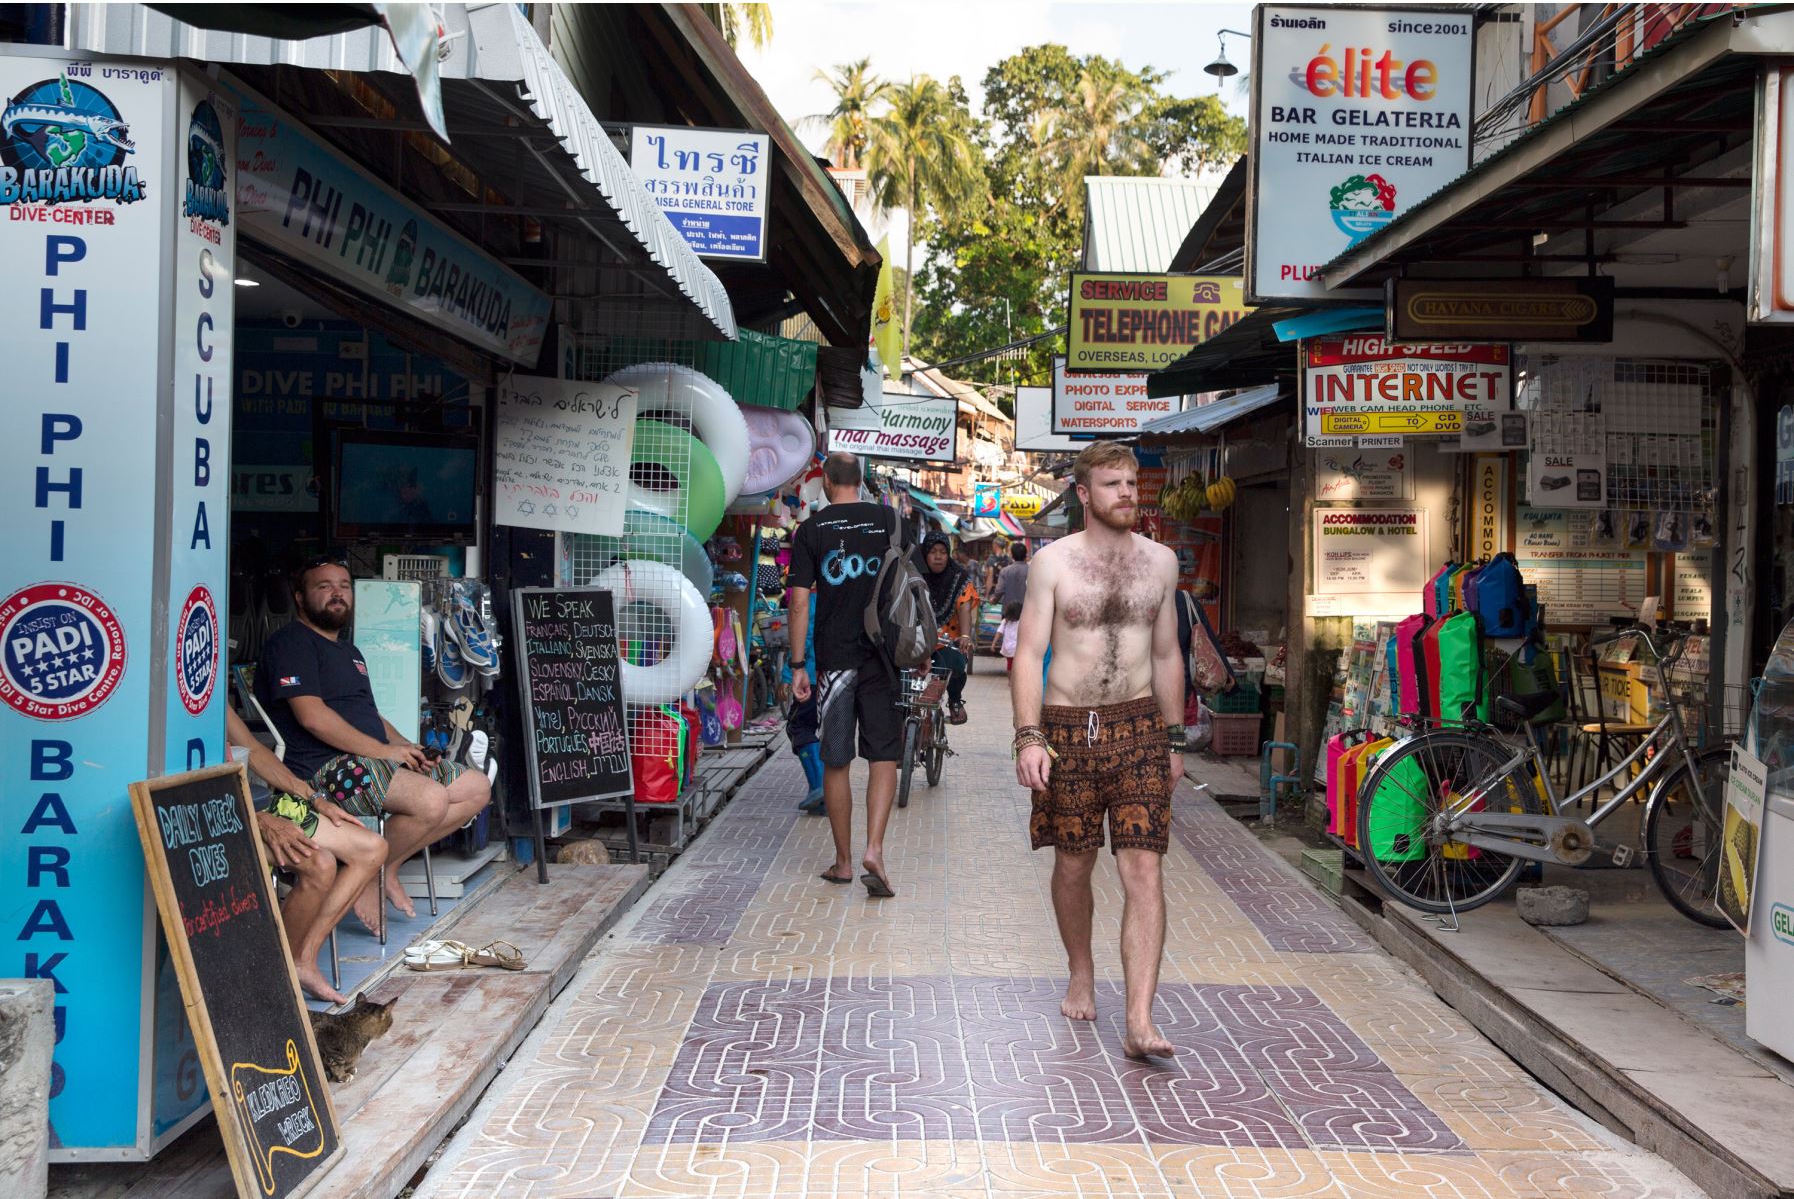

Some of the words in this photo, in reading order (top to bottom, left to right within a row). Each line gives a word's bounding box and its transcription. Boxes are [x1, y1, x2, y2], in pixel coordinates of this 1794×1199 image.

[1306, 43, 1438, 101] élite
[1271, 106, 1317, 124] BAR
[1332, 109, 1461, 129] GELATERIA
[1269, 132, 1310, 143] HOME
[1315, 134, 1355, 145] MADE
[1361, 135, 1462, 148] TRADITIONAL
[646, 134, 758, 175] ไทรซี
[1297, 153, 1354, 164] ITALIAN
[1359, 155, 1381, 165] ICE
[1387, 156, 1433, 167] CREAM
[645, 175, 756, 200] สรรพสินค้า
[682, 199, 723, 211] GENERAL
[726, 201, 755, 212] STORE
[282, 167, 342, 249] PHI
[340, 202, 392, 275] PHI
[414, 247, 511, 340] BARAKUDA
[1080, 280, 1168, 301] SERVICE
[40, 235, 87, 383] PHI
[1424, 301, 1493, 315] HAVANA
[1501, 301, 1558, 315] CIGARS
[1080, 308, 1200, 345] TELEPHONE
[1078, 351, 1148, 365] OVERSEAS,
[1342, 339, 1393, 355] HIGH
[242, 370, 312, 395] DIVE
[326, 372, 378, 397] PHI
[1065, 385, 1109, 395] PHOTO
[1315, 372, 1502, 402] INTERNET
[190, 248, 214, 550] SCUBA
[1075, 401, 1115, 411] DIGITAL
[1127, 401, 1170, 412] SERVICE
[881, 409, 952, 435] Harmony
[1061, 417, 1137, 428] WATERSPORTS
[1435, 422, 1460, 430] DVD
[1466, 411, 1495, 421] SALE
[875, 432, 950, 456] massage
[1307, 436, 1352, 447] Scanner
[1361, 437, 1400, 446] PRINTER
[1545, 456, 1573, 466] SALE
[35, 413, 83, 562] PHI
[1323, 514, 1417, 525] ACCOMMODATION
[1323, 526, 1375, 535] BUNGALOW
[1378, 527, 1386, 535] &
[1388, 526, 1417, 535] HOTEL
[528, 596, 550, 620] WE
[12, 621, 93, 664] PADI
[185, 621, 210, 661] PADI
[14, 694, 23, 705] 5
[26, 701, 53, 715] Star
[58, 701, 87, 715] Dive
[109, 620, 123, 660] Resort
[30, 678, 43, 694] 5
[47, 664, 96, 690] STAR
[190, 680, 196, 692] 5
[195, 660, 211, 688] STAR
